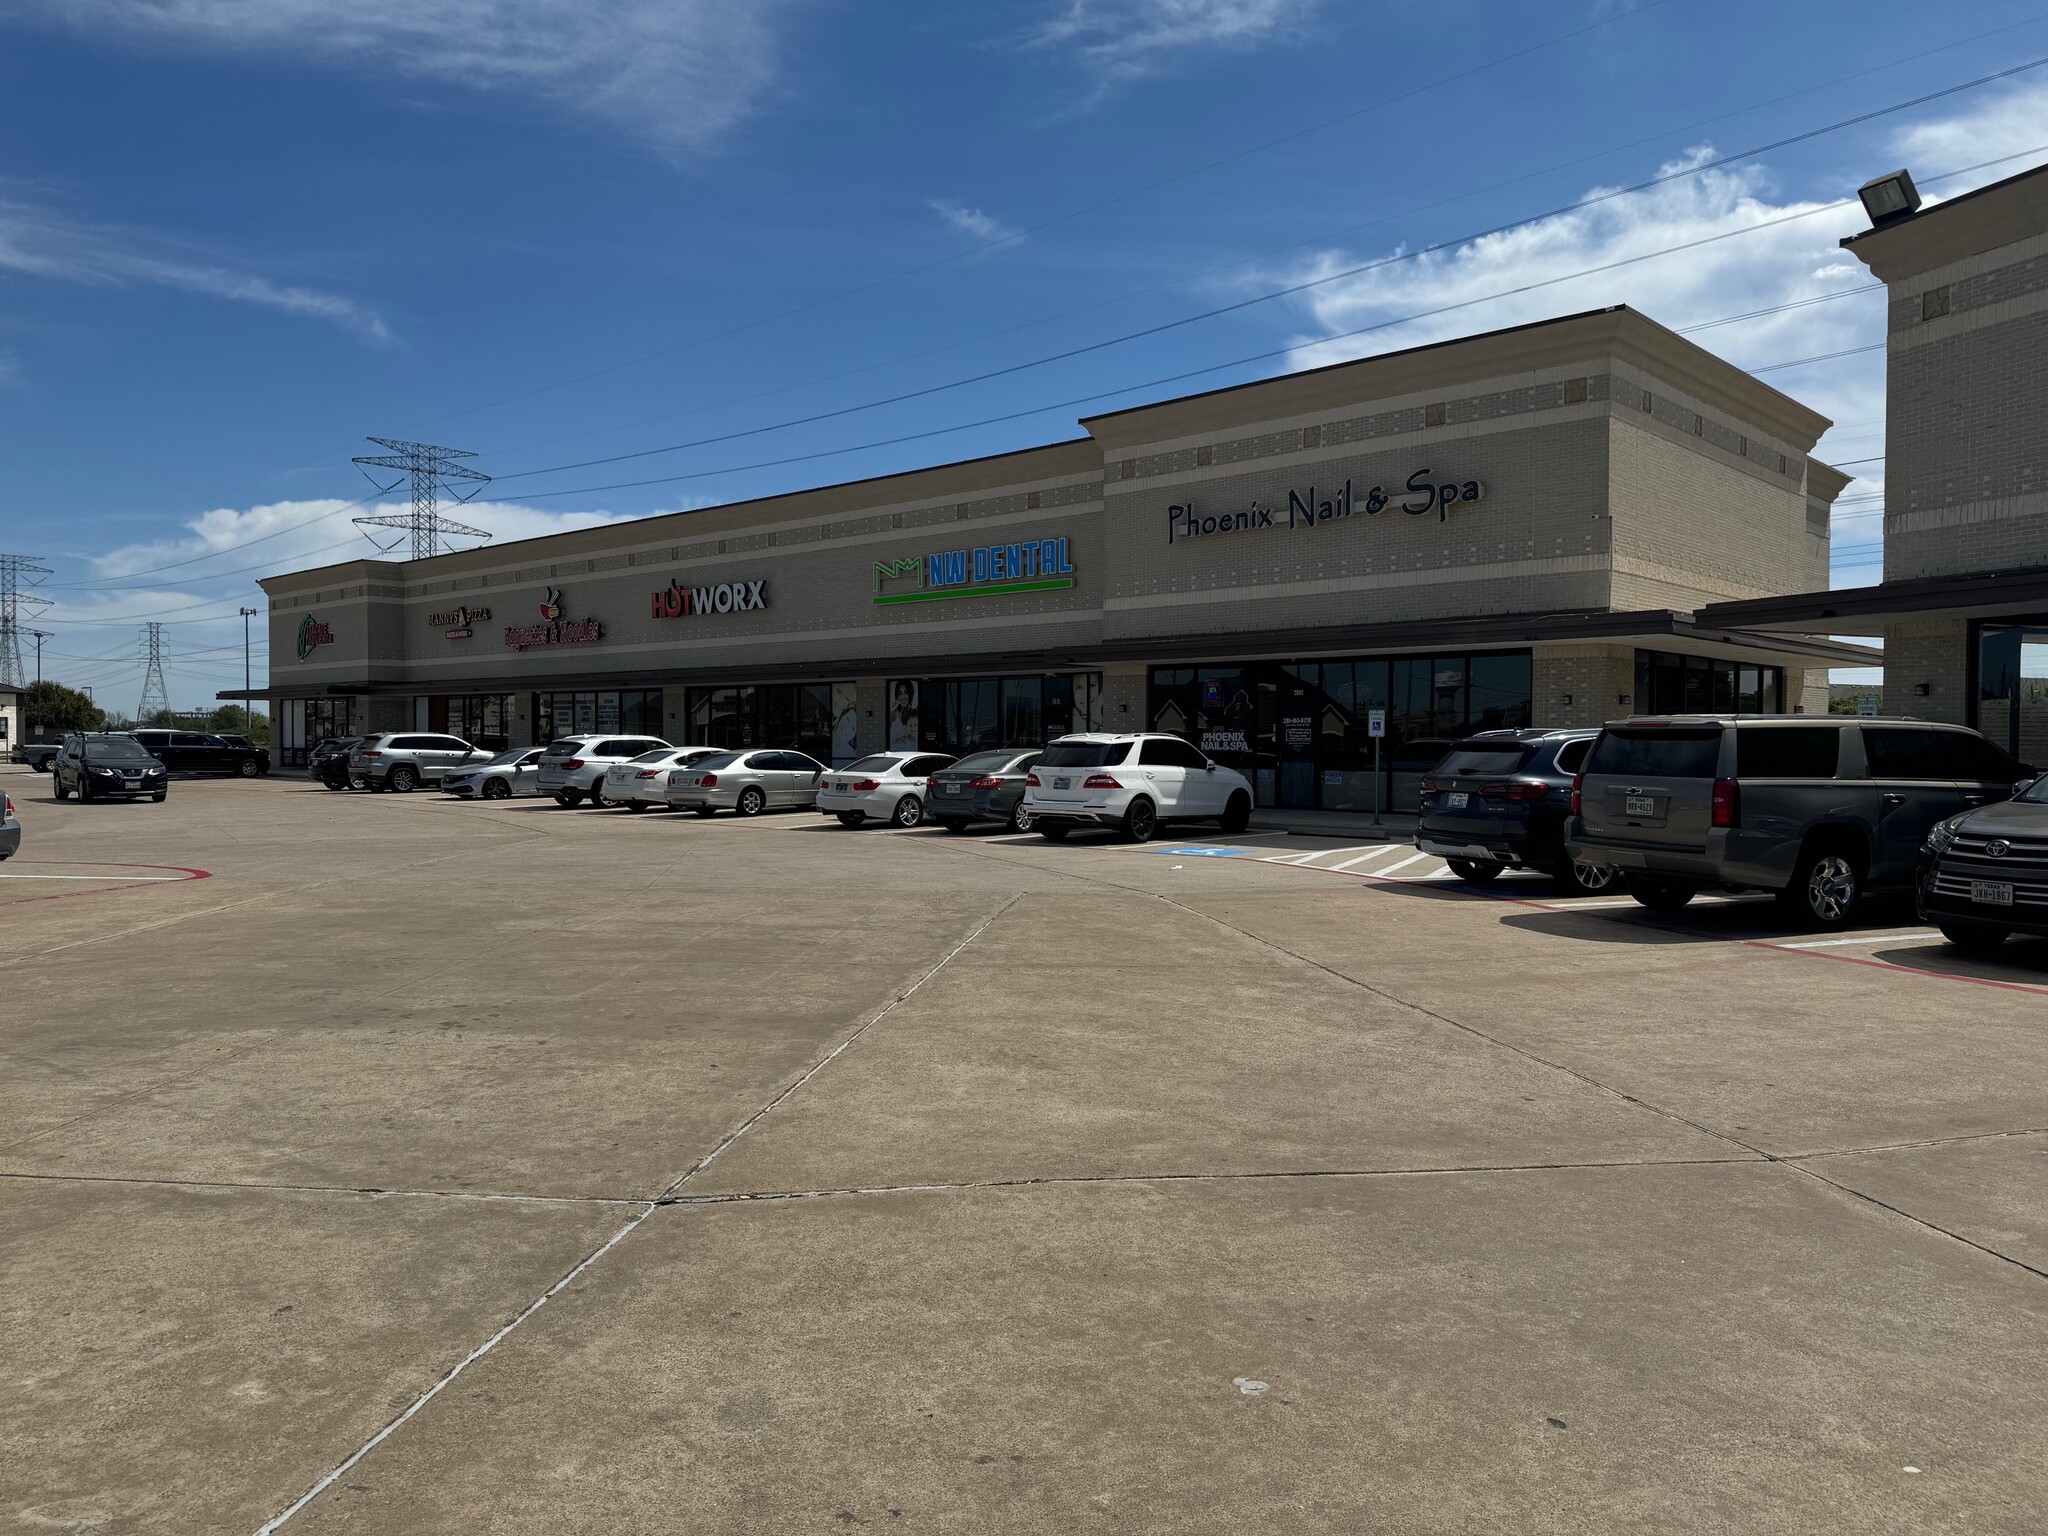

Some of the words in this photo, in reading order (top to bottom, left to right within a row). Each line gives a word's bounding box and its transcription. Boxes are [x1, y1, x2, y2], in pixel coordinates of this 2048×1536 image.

[1168, 501, 1274, 545] Phoenix
[1288, 478, 1352, 530] Nail
[1365, 485, 1390, 515] &
[1401, 468, 1481, 523] Spa
[929, 550, 966, 587] NW
[973, 537, 1073, 582] DENTAL
[466, 608, 489, 622] PIZZA
[504, 626, 548, 652] Baguettes
[560, 617, 600, 643] Noodles
[1202, 732, 1245, 742] PHOENIX
